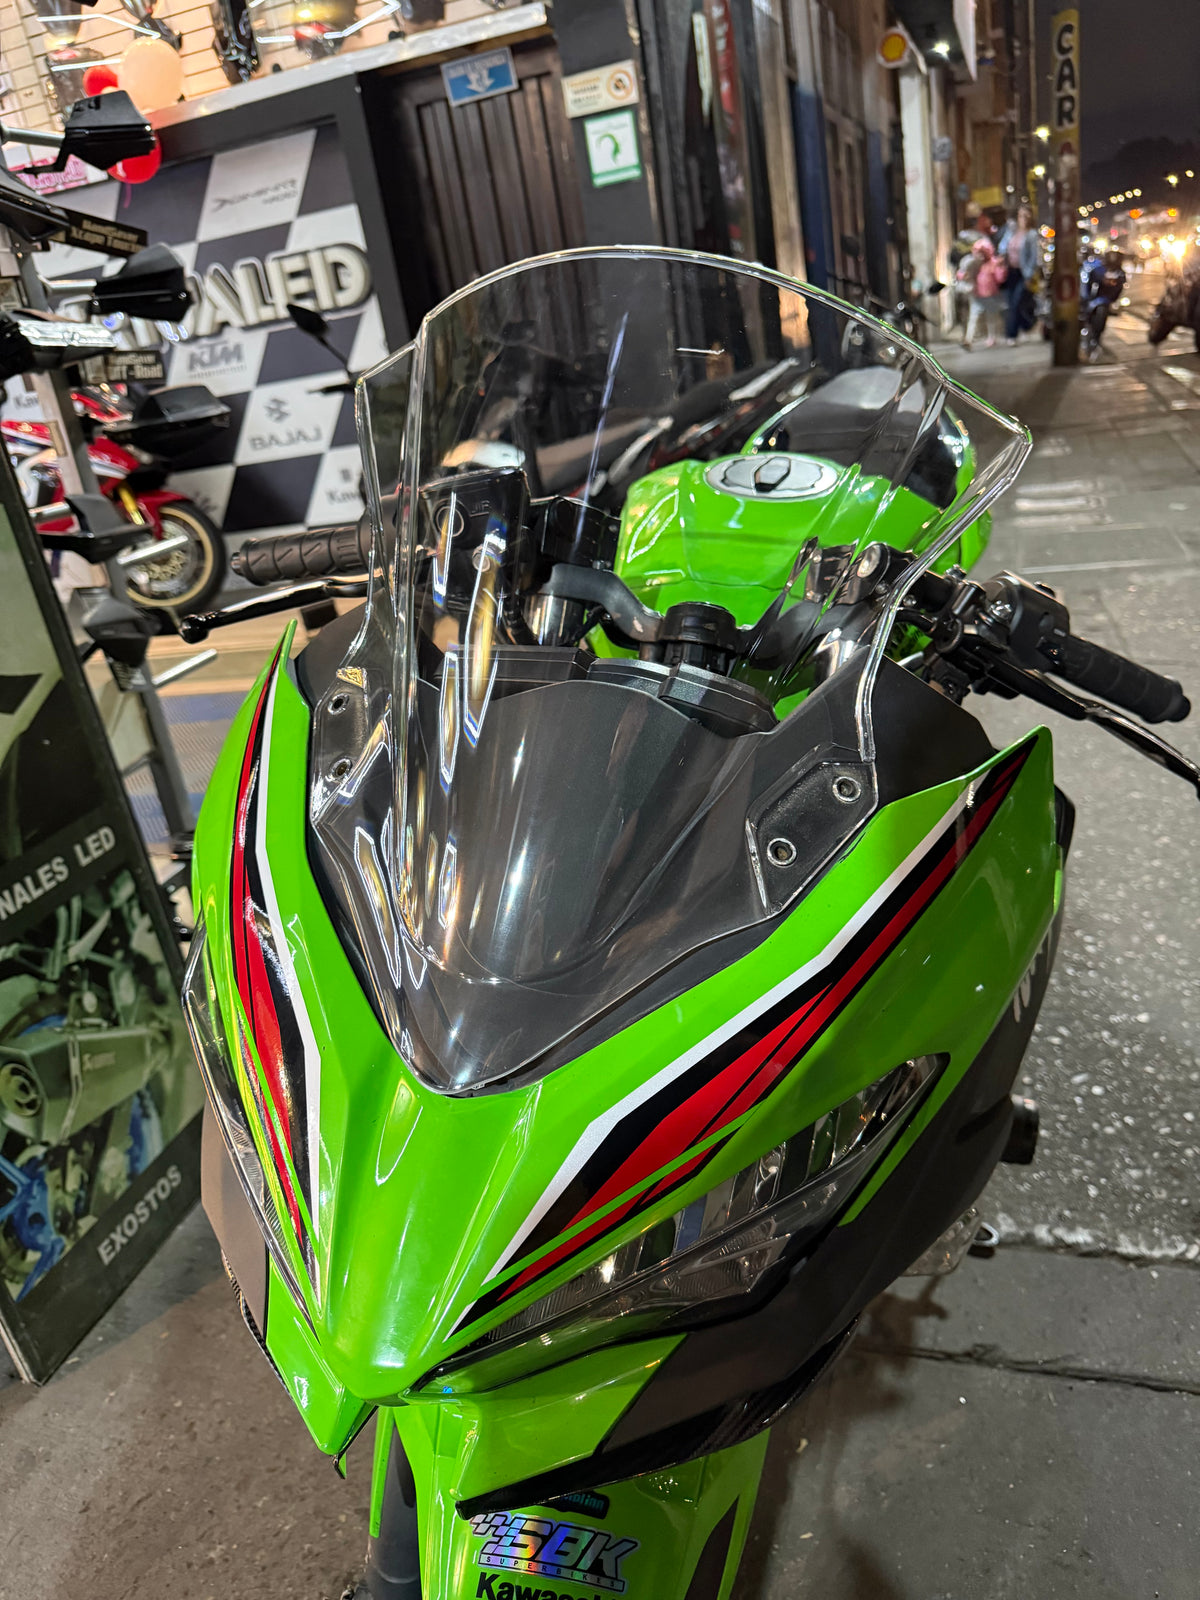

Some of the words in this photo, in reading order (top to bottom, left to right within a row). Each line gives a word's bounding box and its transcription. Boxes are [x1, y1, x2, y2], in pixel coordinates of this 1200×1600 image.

[1055, 23, 1077, 128] CAR
[188, 341, 245, 371] KTM
[250, 426, 324, 451] BAJAJ
[74, 826, 116, 867] LED
[97, 1165, 182, 1266] EXOSTOS
[472, 1514, 639, 1578] SBK
[485, 1555, 616, 1588] SUPERBIKES
